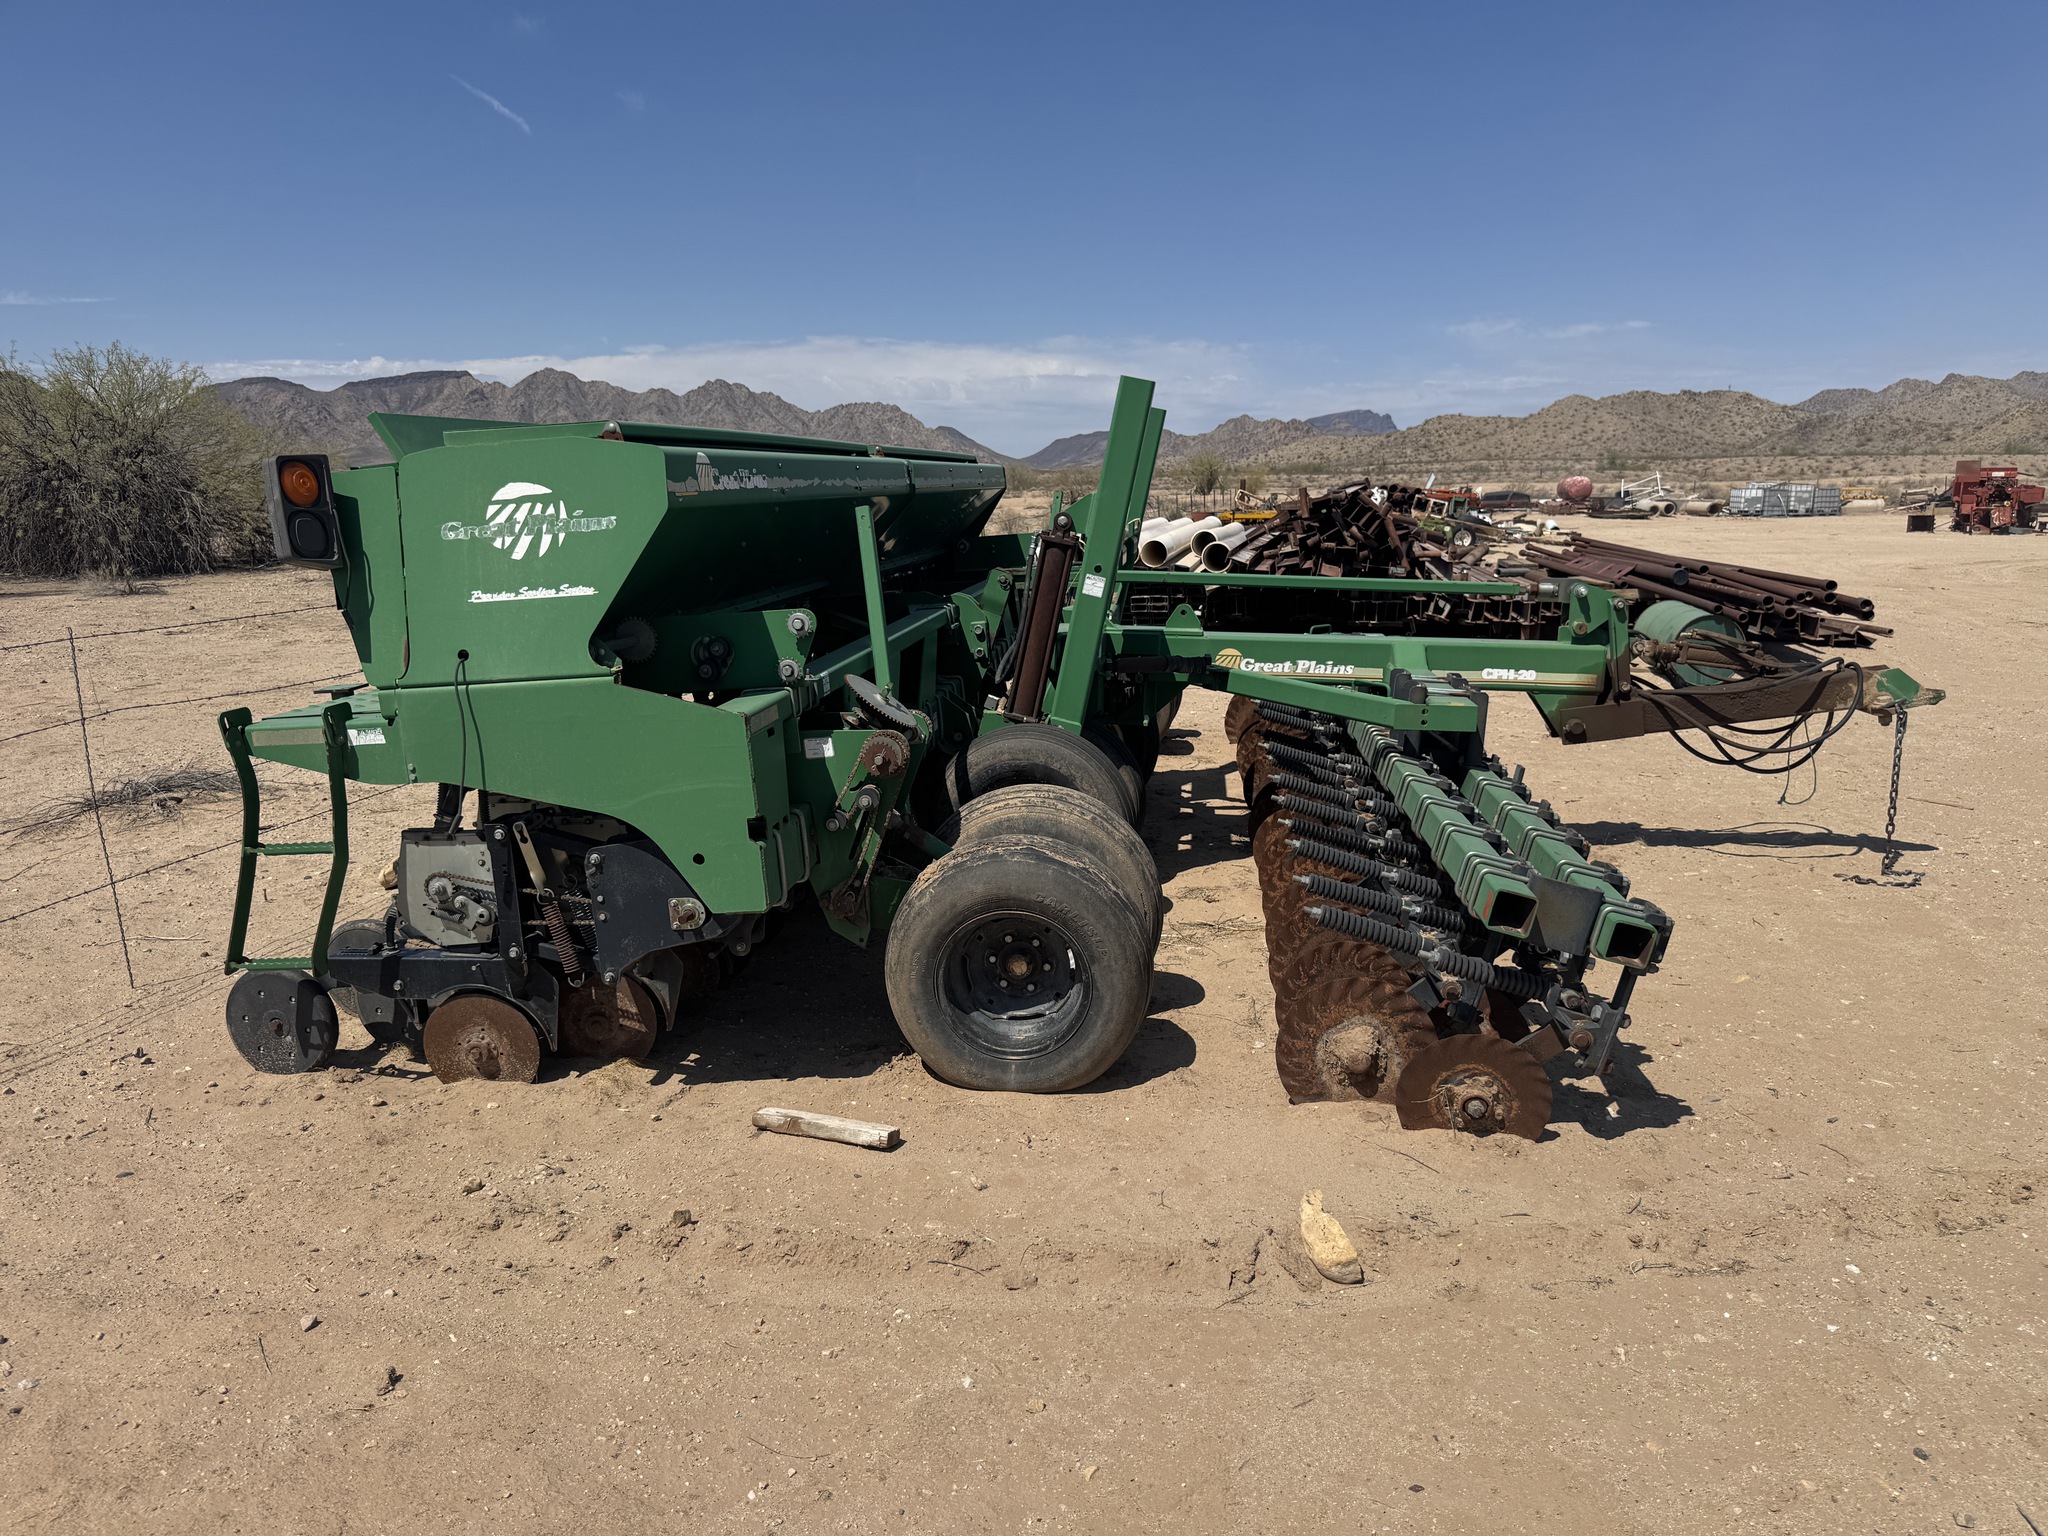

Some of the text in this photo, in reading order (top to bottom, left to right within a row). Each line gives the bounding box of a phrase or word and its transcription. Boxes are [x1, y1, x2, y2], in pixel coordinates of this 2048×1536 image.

[1239, 658, 1355, 675] Great Plains
[1481, 667, 1537, 681] CPH-20
